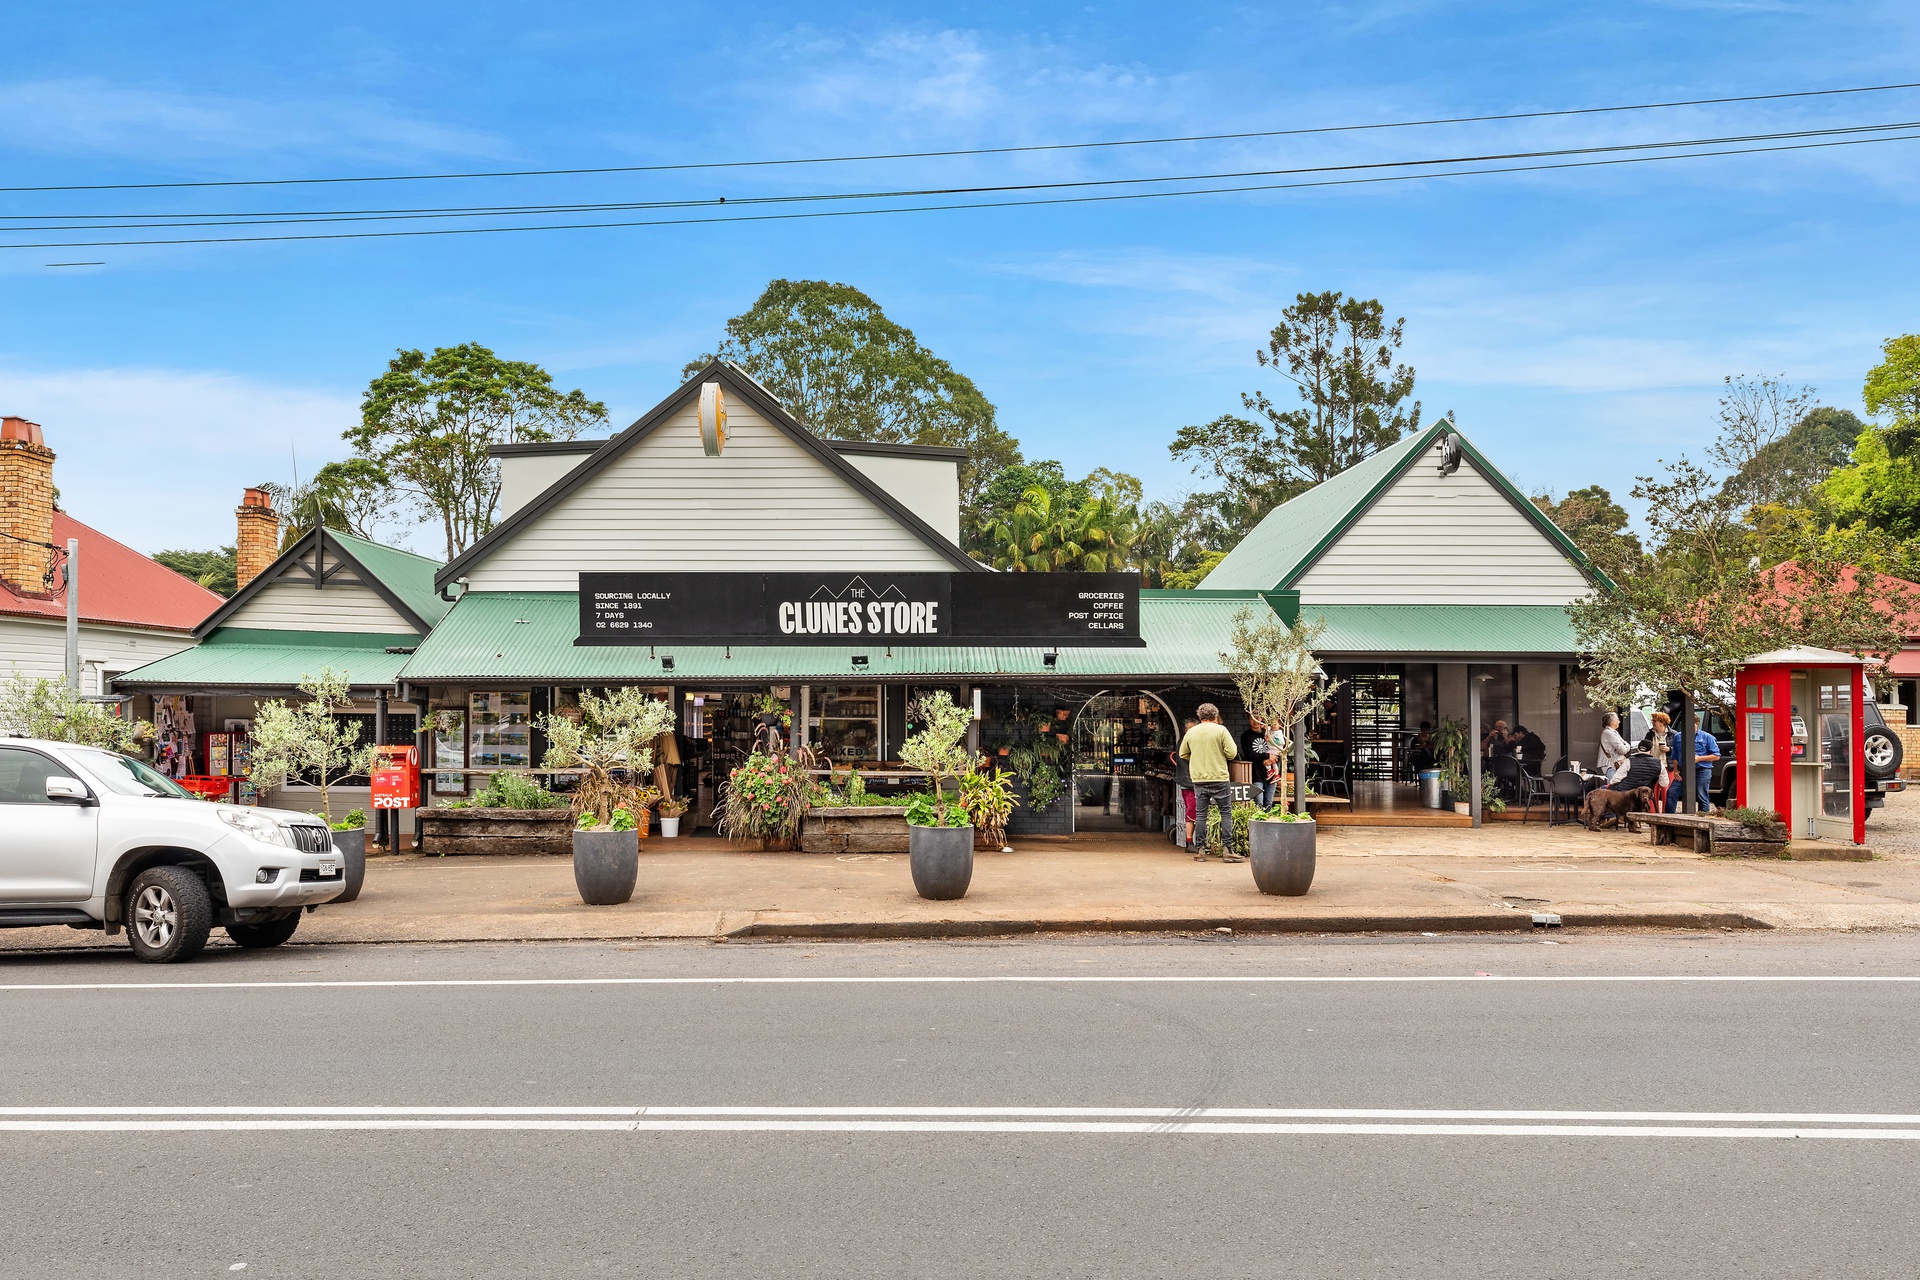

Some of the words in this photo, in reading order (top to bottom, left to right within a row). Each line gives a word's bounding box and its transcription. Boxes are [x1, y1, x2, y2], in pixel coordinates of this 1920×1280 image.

[594, 592, 634, 600] SOURCING
[636, 592, 672, 600] LOCALLY
[850, 588, 866, 599] THE
[1078, 592, 1125, 600] GROCERIES
[594, 602, 620, 610] SINCE
[623, 602, 643, 610] 1891
[1093, 602, 1124, 610] COFFEE
[604, 611, 625, 619] DAYS
[778, 601, 863, 635] CLUNES
[866, 601, 939, 635] STORE
[1068, 612, 1090, 620] POST
[1092, 612, 1124, 620] OFFICE
[595, 621, 607, 629] 02
[609, 621, 630, 629] 6629
[632, 621, 653, 629] 1340
[1087, 622, 1125, 630] CELLARS
[373, 797, 410, 808] POST
